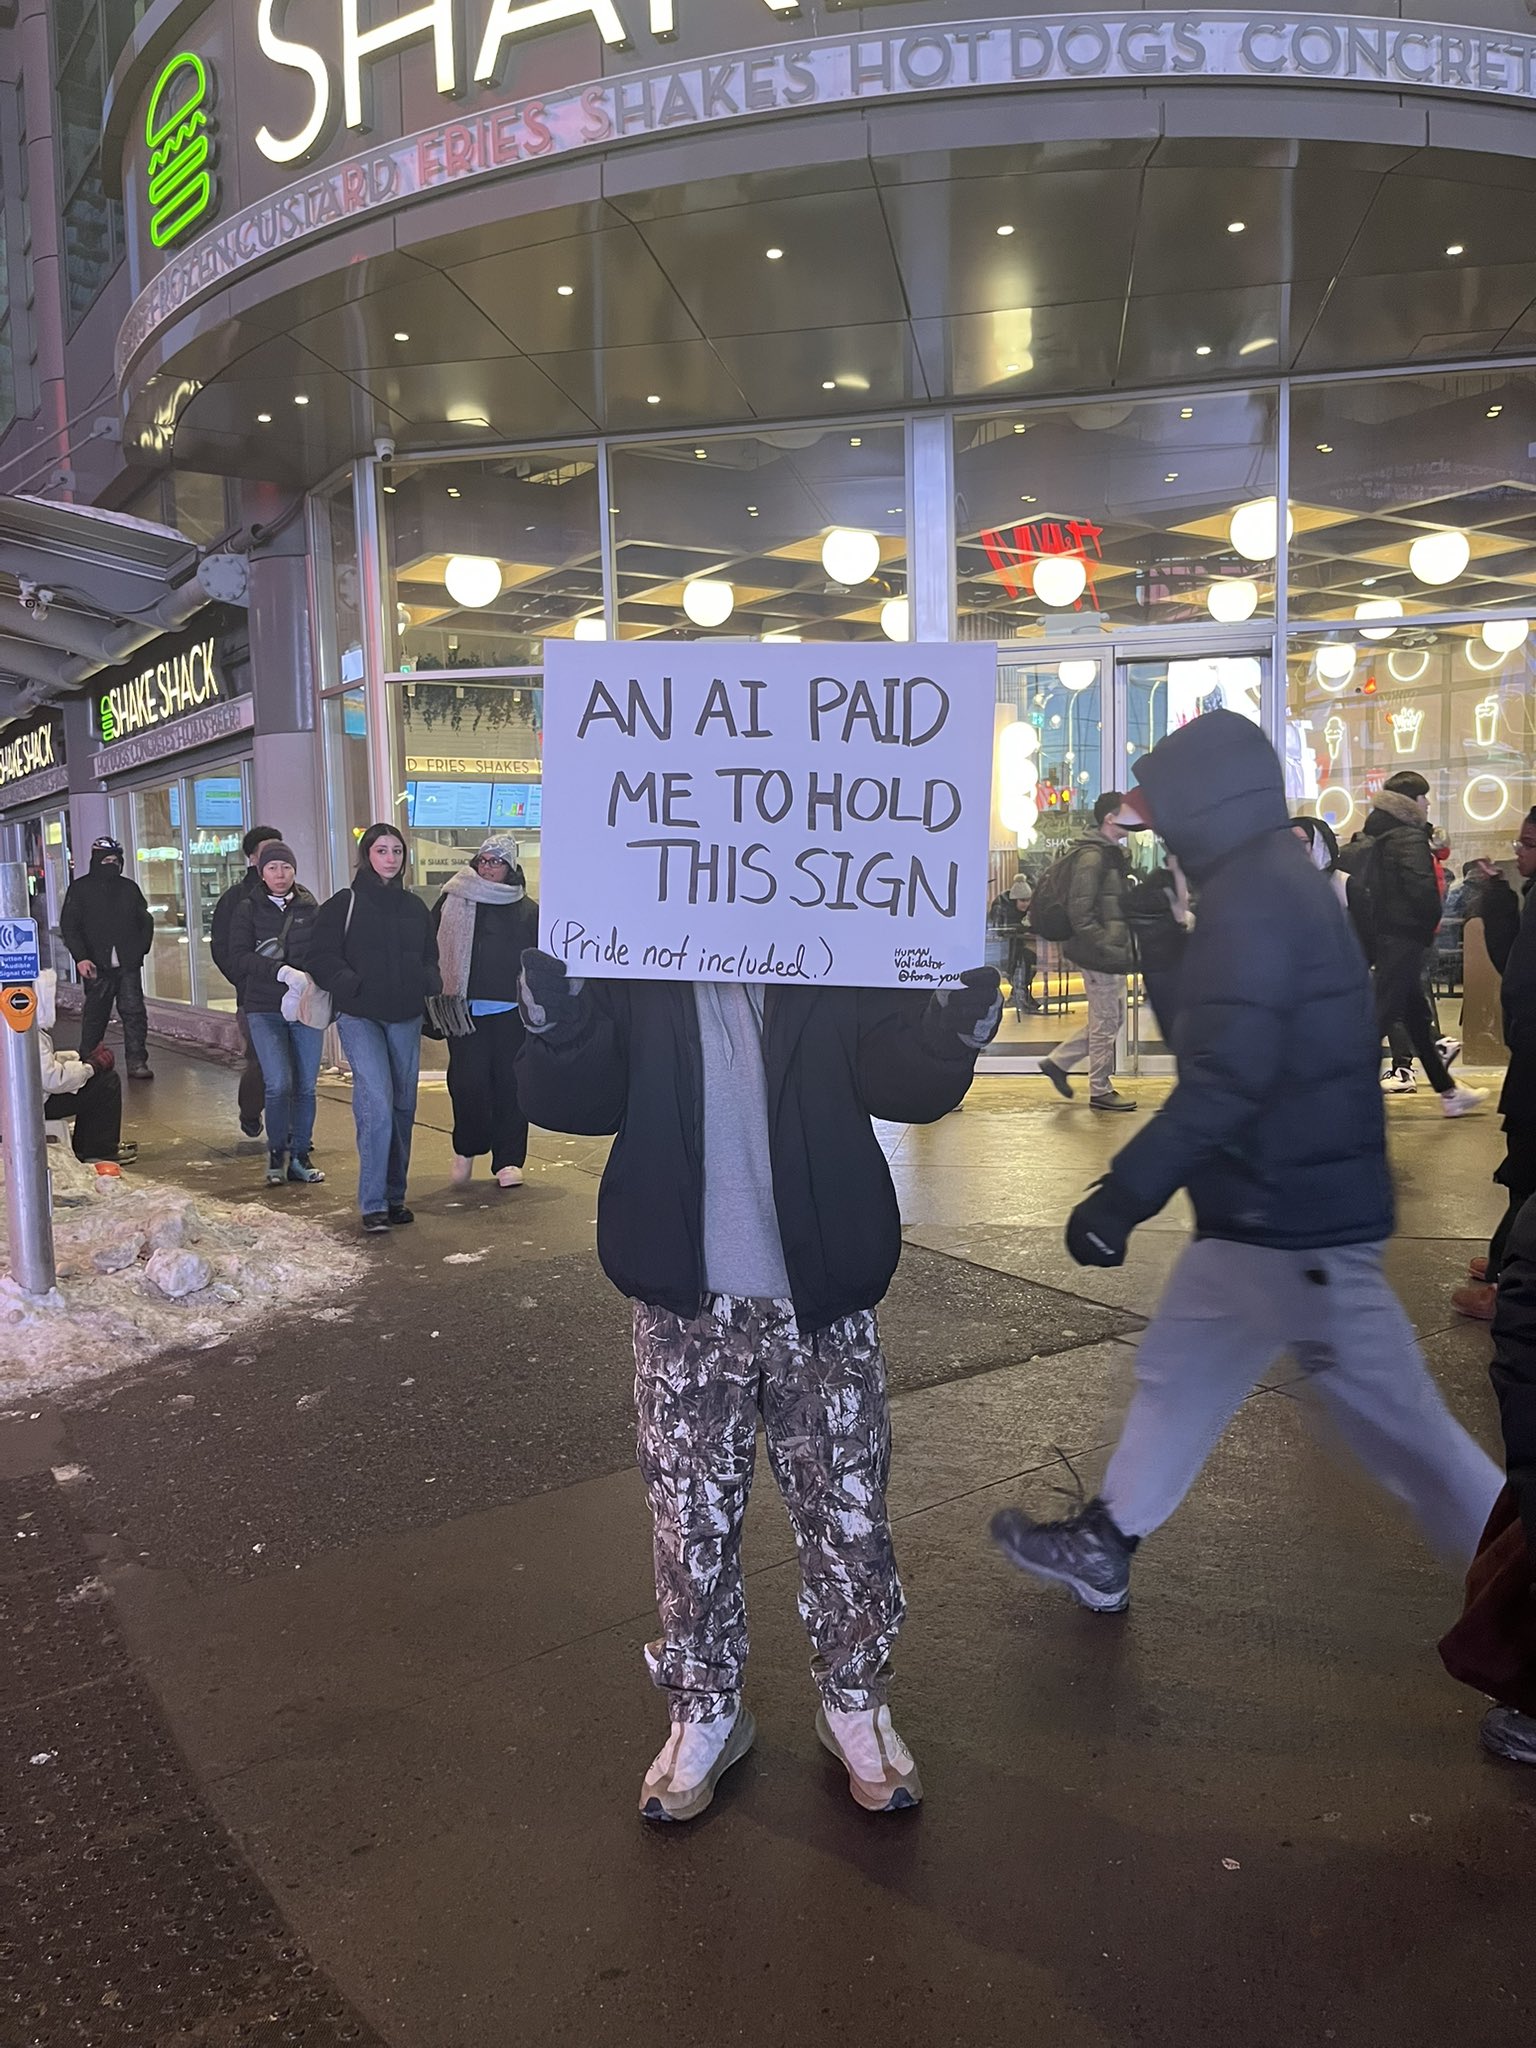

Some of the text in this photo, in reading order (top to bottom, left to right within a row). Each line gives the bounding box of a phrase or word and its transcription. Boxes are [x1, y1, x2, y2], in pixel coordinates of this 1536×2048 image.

[236, 157, 398, 259] CUSTARD
[416, 101, 553, 187] FRIES
[580, 50, 818, 142] SHAKES
[850, 29, 993, 95] HOT
[1011, 17, 1206, 80] DOGS
[109, 637, 219, 739] SHAKE SHACK
[577, 677, 950, 746] AN AI PAID
[23, 722, 54, 774] SHACK
[427, 759, 466, 773] FRIES
[475, 760, 530, 774] SHAKES
[607, 771, 701, 828] ME
[715, 768, 793, 824] TO
[807, 771, 962, 833] HOLD
[626, 839, 958, 918] THIS SIGN
[21, 969, 37, 977] Only
[550, 919, 834, 979] (Pride not included.)
[894, 955, 946, 970] Validator
